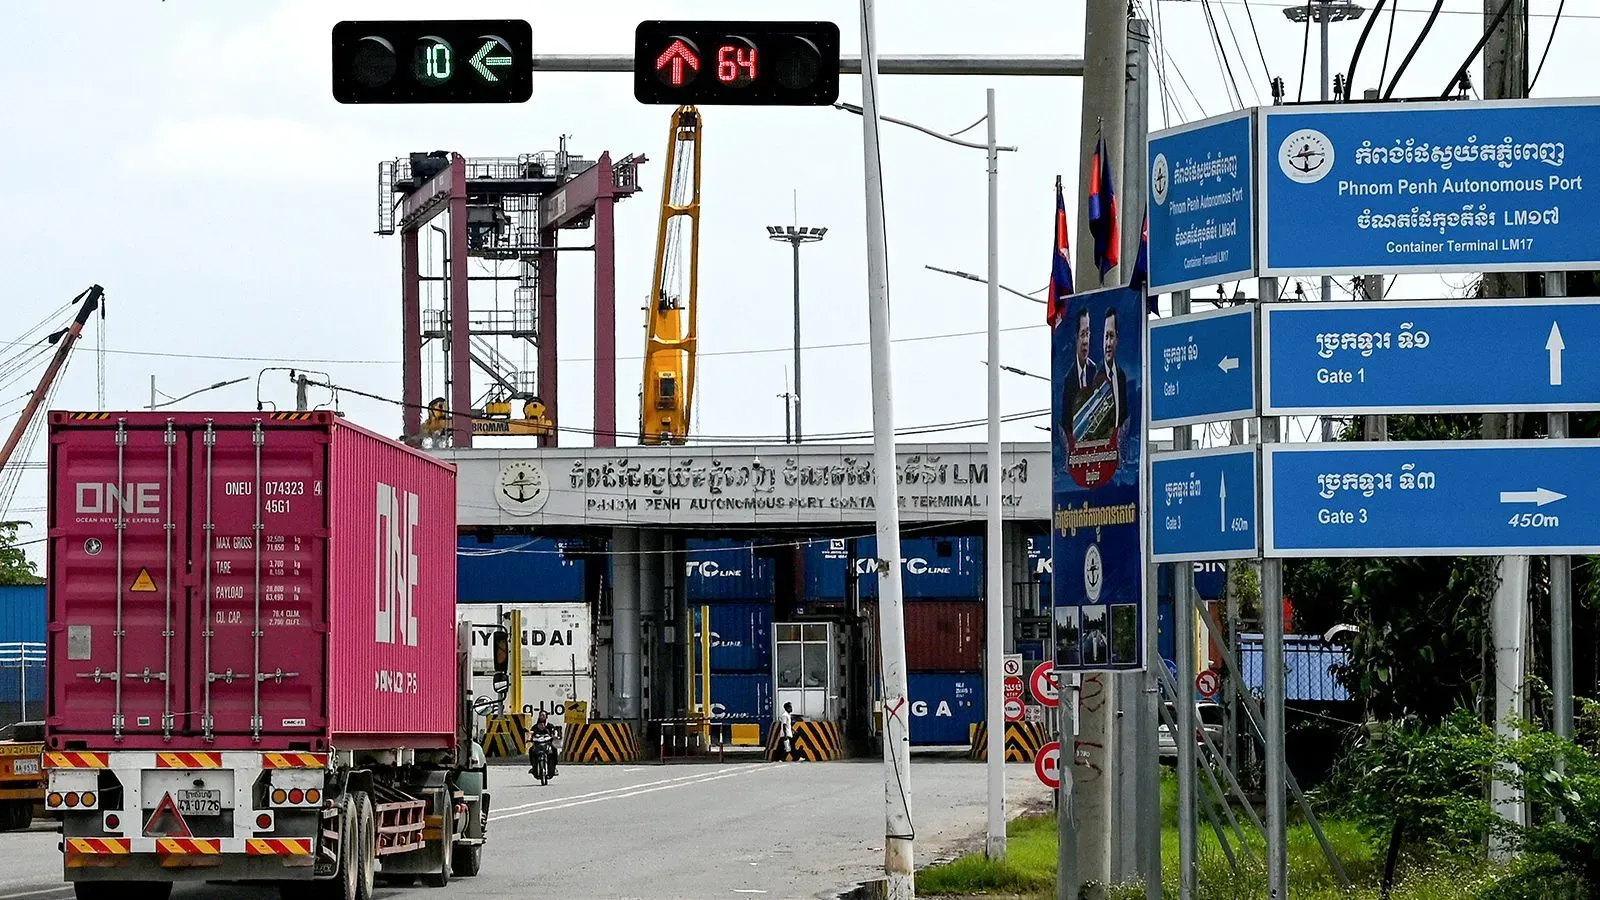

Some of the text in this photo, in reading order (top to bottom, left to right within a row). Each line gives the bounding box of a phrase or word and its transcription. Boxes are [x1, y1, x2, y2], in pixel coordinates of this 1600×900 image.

[426, 44, 450, 78] 10
[718, 45, 756, 81] 64
[1355, 135, 1565, 169] កំពង់ផែស្វយ័តភ្នំពេញ
[1338, 174, 1583, 196] Phnom Penh Autonomous Port
[1169, 187, 1243, 215] Phnom Penh Autonomous Port
[1504, 207, 1559, 226] LM១៧
[1386, 238, 1534, 253] Container Terminal LM17
[1316, 322, 1430, 358] ច្រកទ្វារ ទី១
[1317, 367, 1365, 384] Gate 1
[1164, 382, 1176, 396] Gate
[472, 423, 510, 433] BROMMA
[225, 481, 322, 496] ONEU 074323 4
[1317, 463, 1436, 499] ច្រកទ្វារ ទី៣
[76, 483, 160, 514] ONE
[265, 500, 290, 513] 45G1
[645, 498, 681, 511] PENH
[690, 497, 785, 510] AUTONOMOUS
[912, 495, 981, 507] TERMINAL
[1165, 516, 1177, 530] Gate
[1231, 517, 1249, 531] 450m
[1318, 508, 1368, 524] Gate 3
[1508, 513, 1559, 528] 450m
[216, 537, 231, 549] MAX
[233, 536, 252, 549] GROSS
[216, 561, 231, 574] TARE
[375, 481, 419, 648] ONE
[216, 586, 244, 599] PAYLOAD
[216, 611, 226, 624] CU.
[228, 611, 242, 624] CAP.
